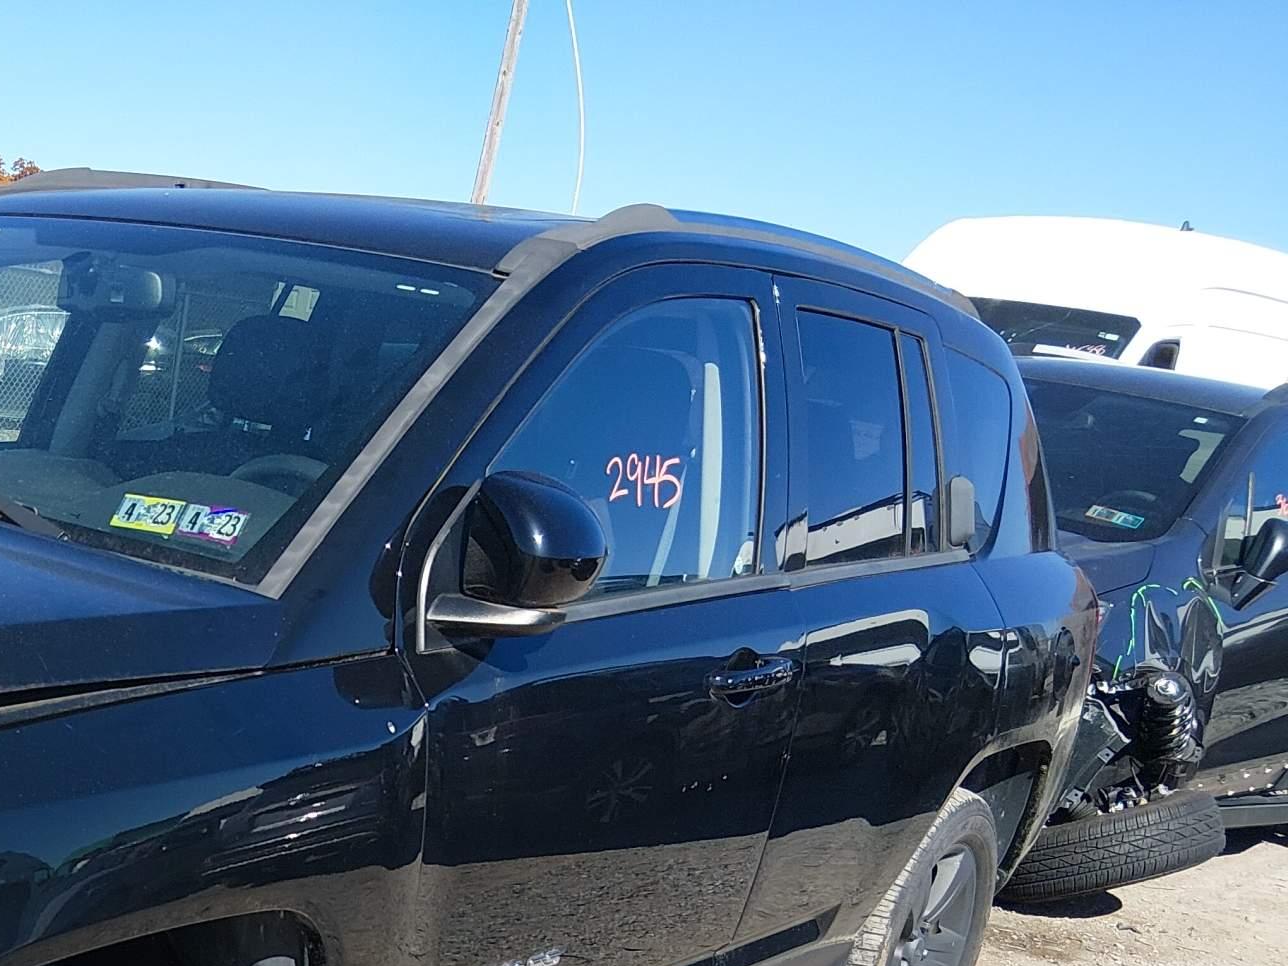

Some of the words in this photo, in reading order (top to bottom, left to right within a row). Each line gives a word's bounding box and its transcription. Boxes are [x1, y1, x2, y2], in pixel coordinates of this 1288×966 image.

[606, 453, 681, 509] 2945
[123, 502, 137, 521] 4
[152, 503, 175, 525] 23
[188, 511, 201, 530] 4
[216, 514, 240, 537] 23
